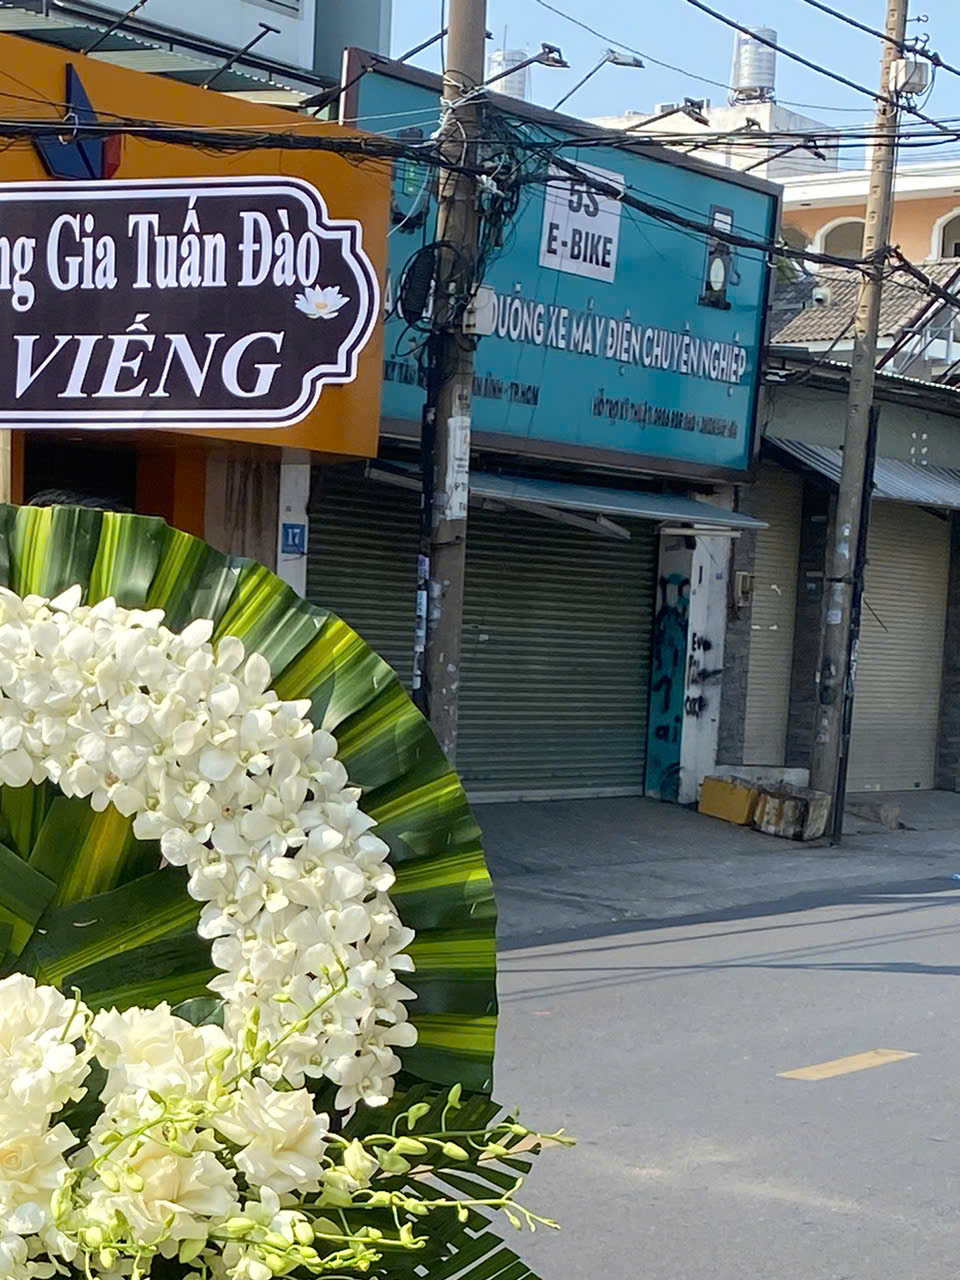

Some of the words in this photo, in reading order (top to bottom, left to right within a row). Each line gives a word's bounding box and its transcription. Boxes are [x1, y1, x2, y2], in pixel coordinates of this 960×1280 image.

[47, 213, 117, 291] Gia
[128, 196, 226, 290] Tuấn
[238, 209, 320, 288] Đào
[11, 313, 285, 398] VIẾNG
[547, 306, 569, 349] XE
[570, 298, 606, 356] MÁY
[643, 321, 699, 375] CHUYÊN
